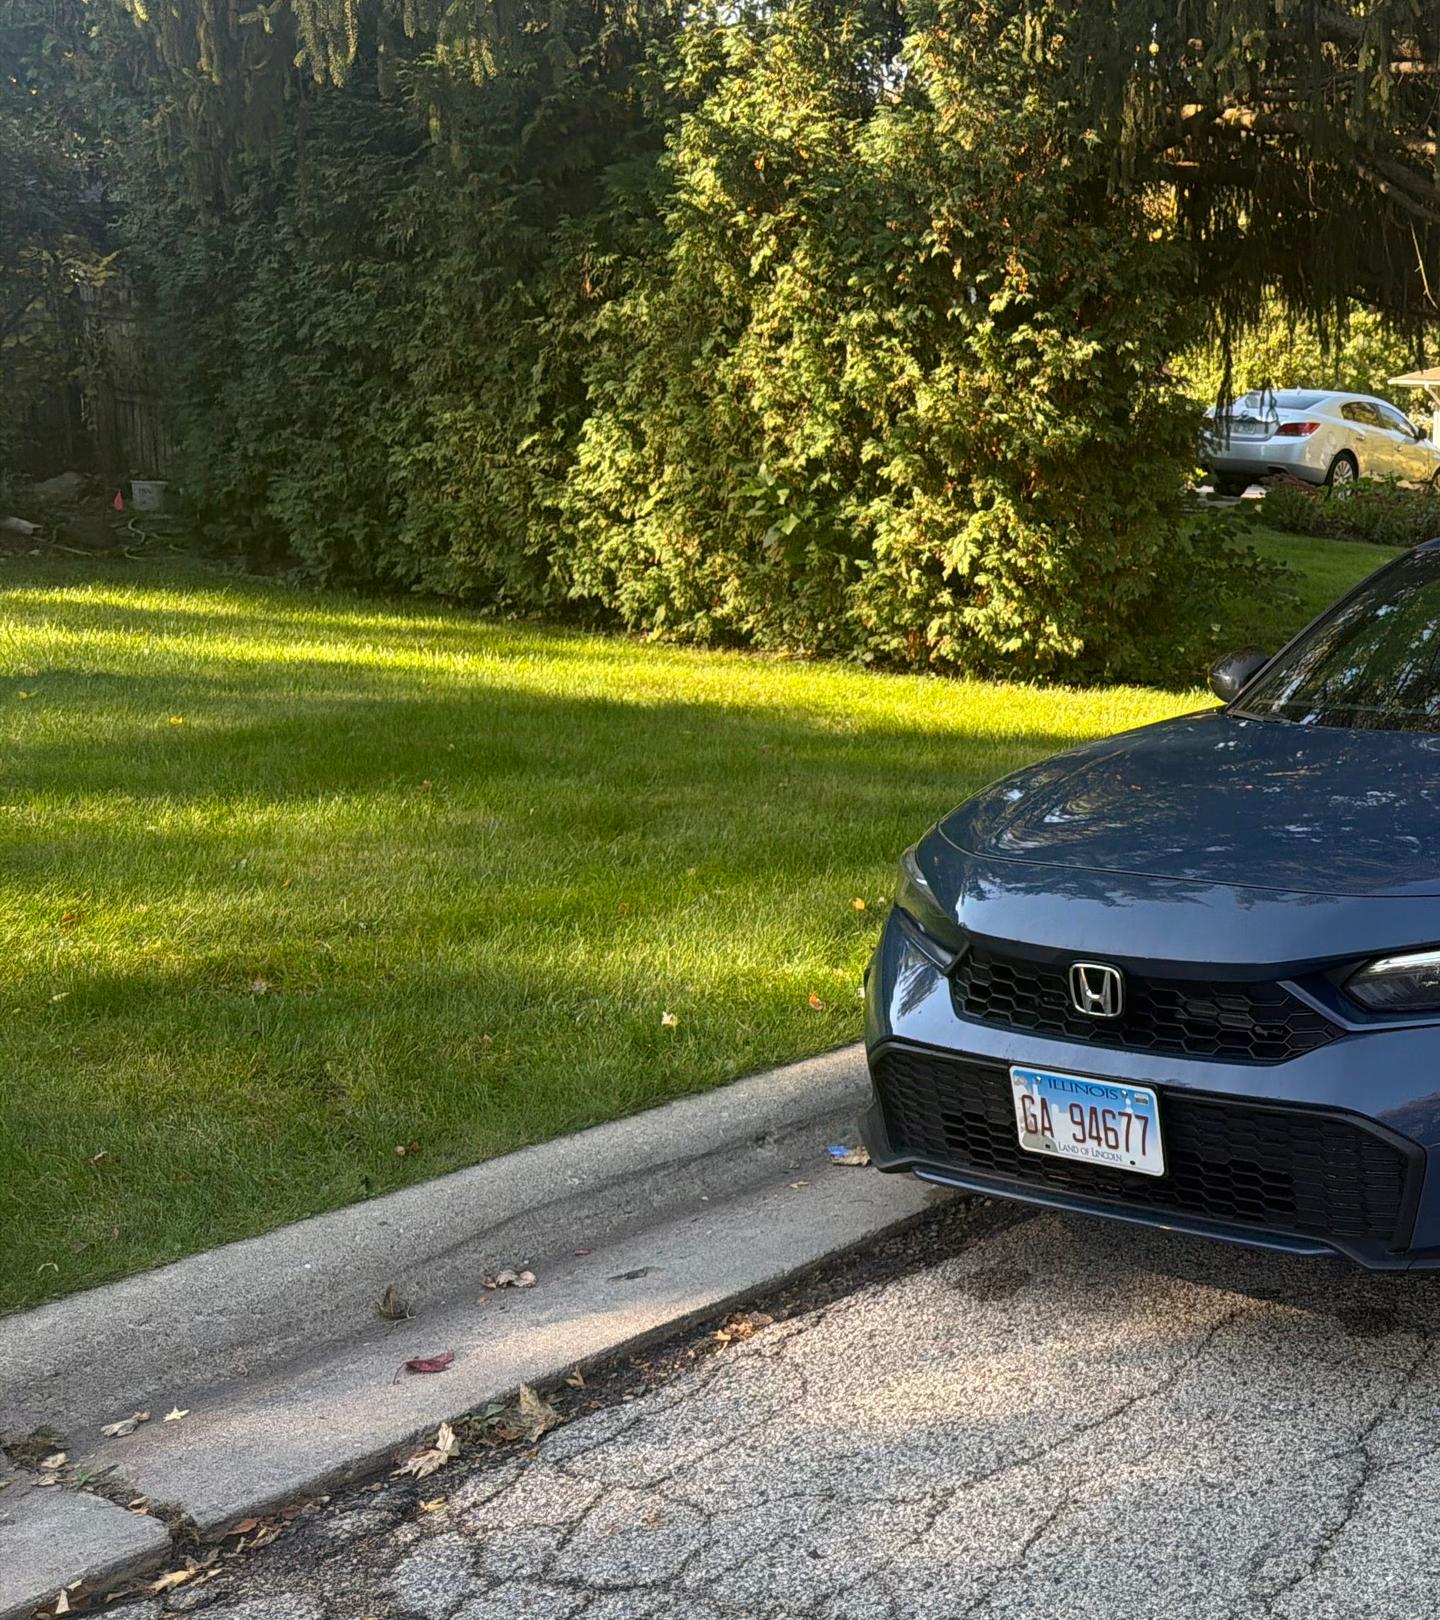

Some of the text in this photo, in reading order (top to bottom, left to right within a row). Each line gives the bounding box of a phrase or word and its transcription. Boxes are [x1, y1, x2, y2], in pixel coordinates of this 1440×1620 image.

[1048, 1080, 1119, 1100] ILLINOIS
[1021, 1094, 1149, 1156] GA 94677
[1058, 1141, 1079, 1154] LAND
[1091, 1148, 1123, 1161] LINCOLN
